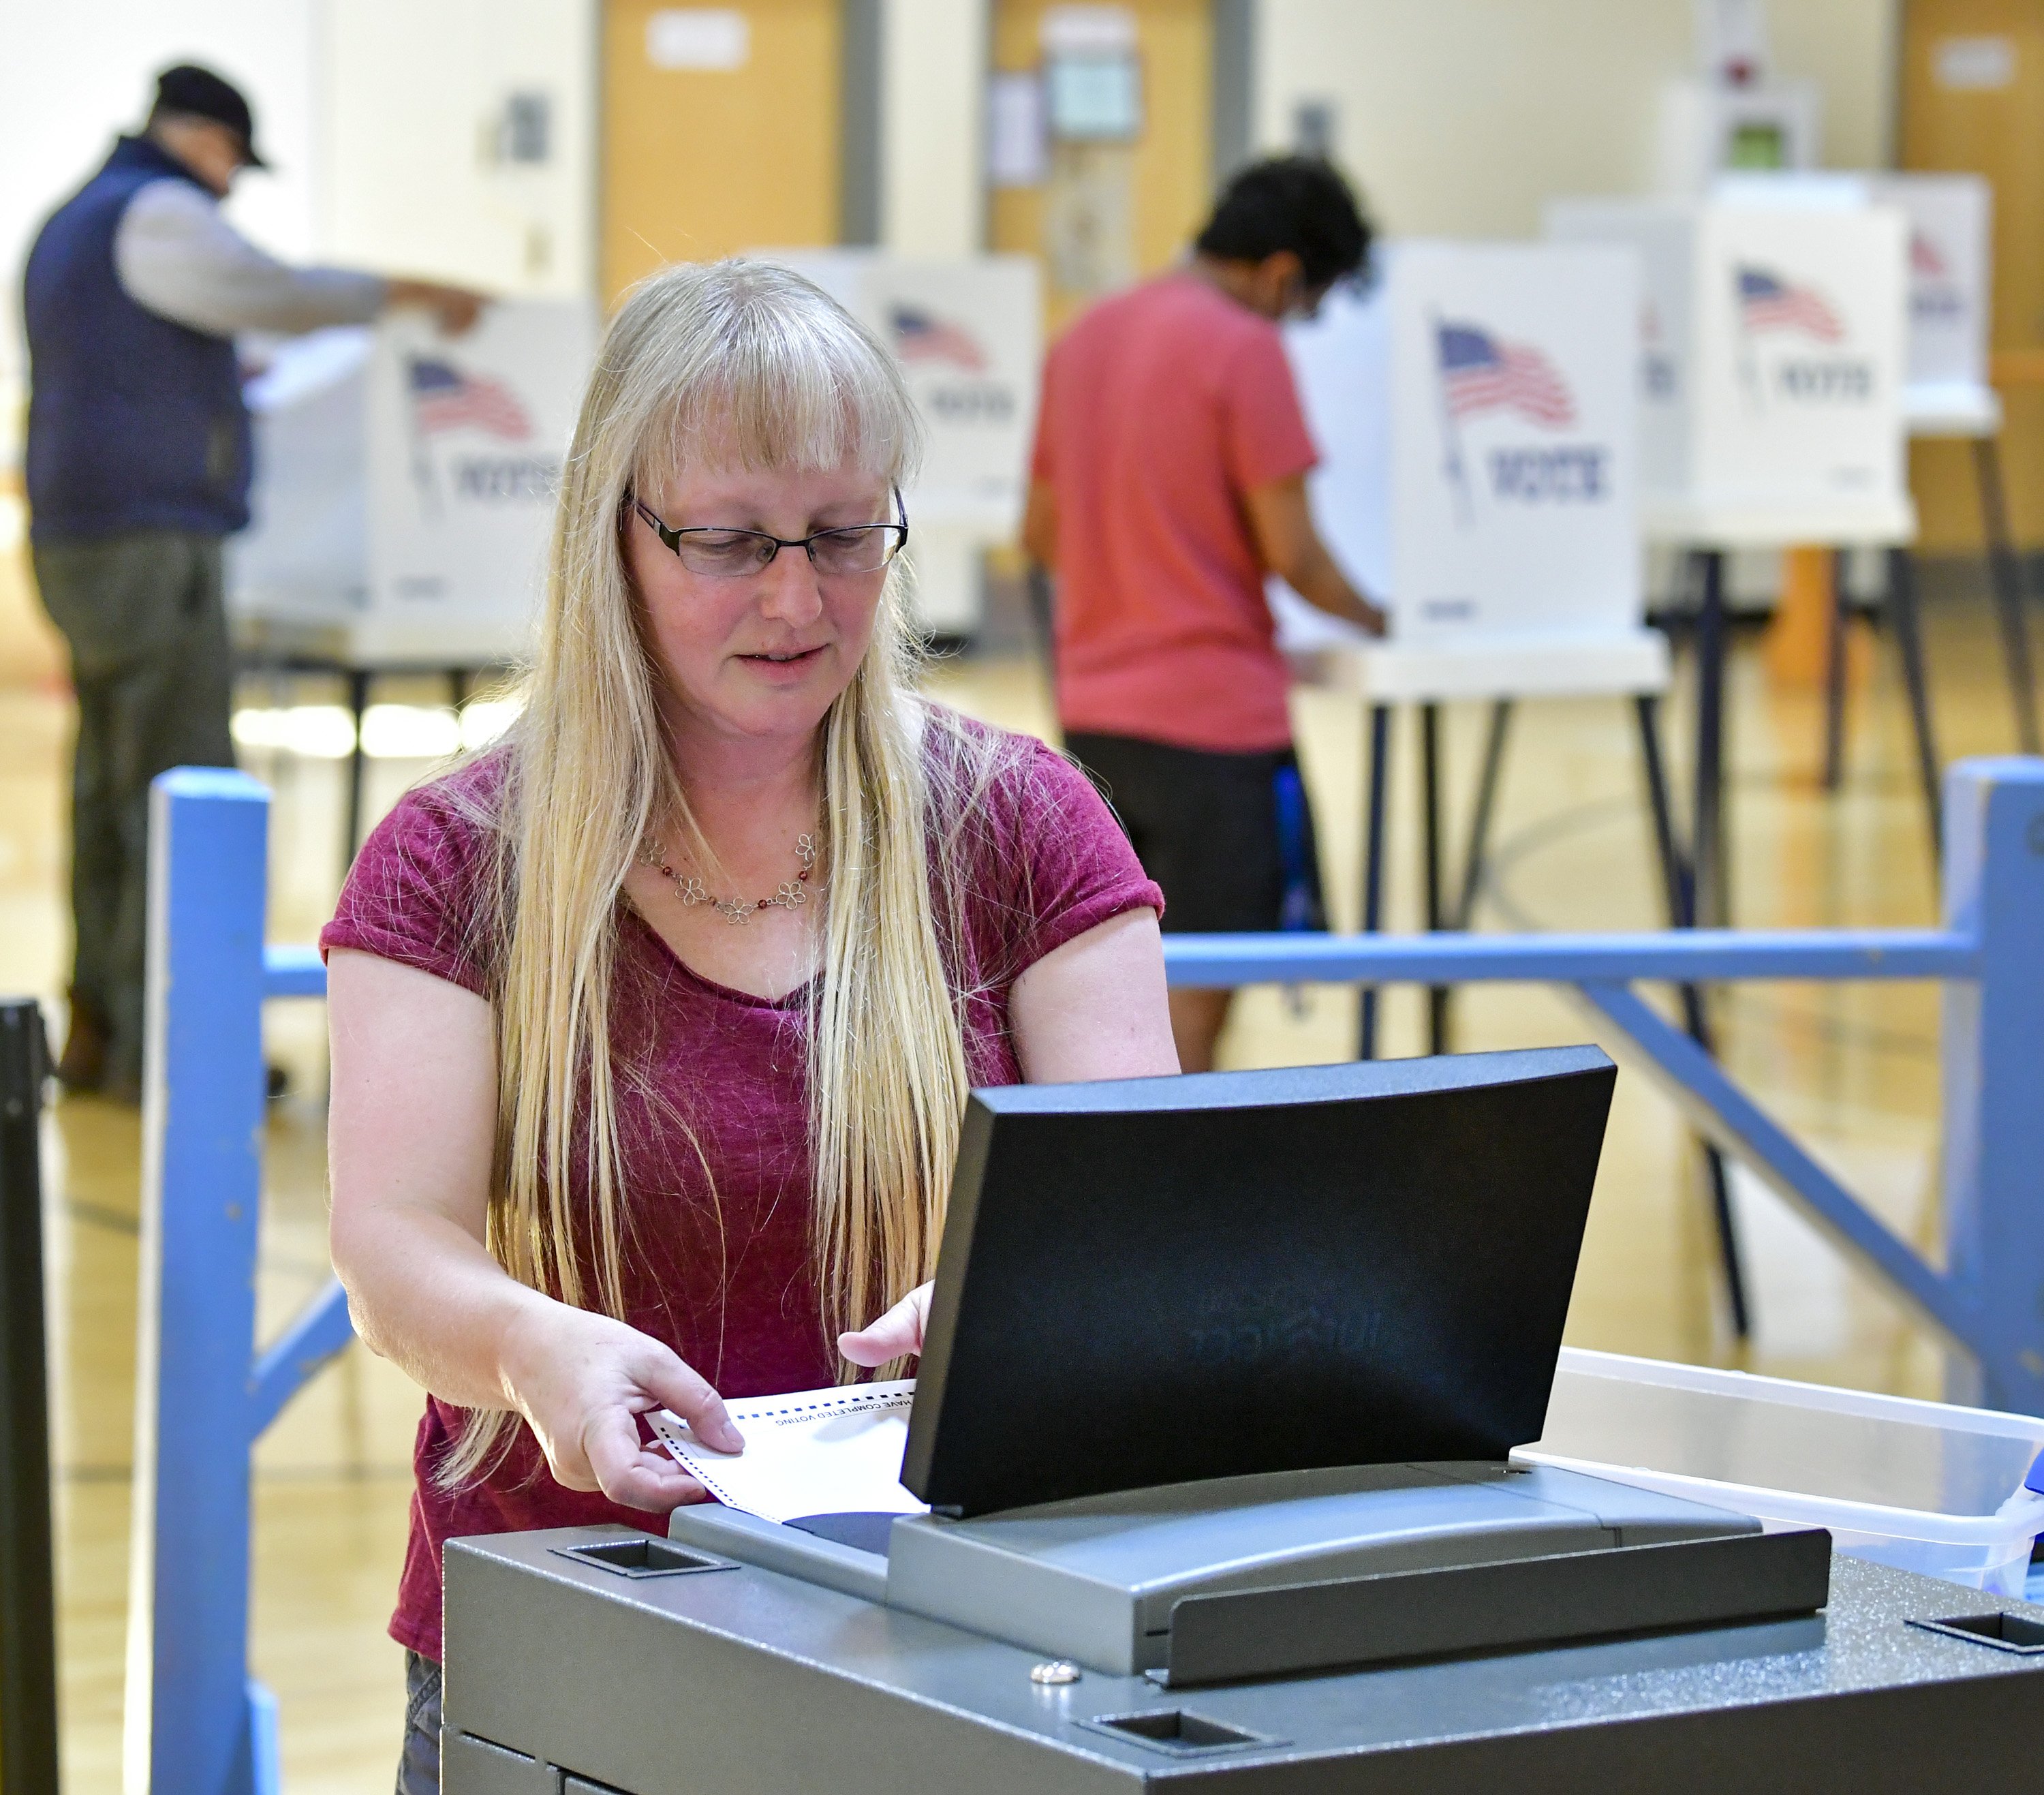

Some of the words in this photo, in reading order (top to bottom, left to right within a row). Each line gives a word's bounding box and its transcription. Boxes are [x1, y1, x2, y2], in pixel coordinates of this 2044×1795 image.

[1489, 446, 1611, 503] VOTE
[818, 1403, 882, 1418] COMPLETED
[882, 1400, 912, 1408] HAVE
[775, 1415, 816, 1426] VOTING
